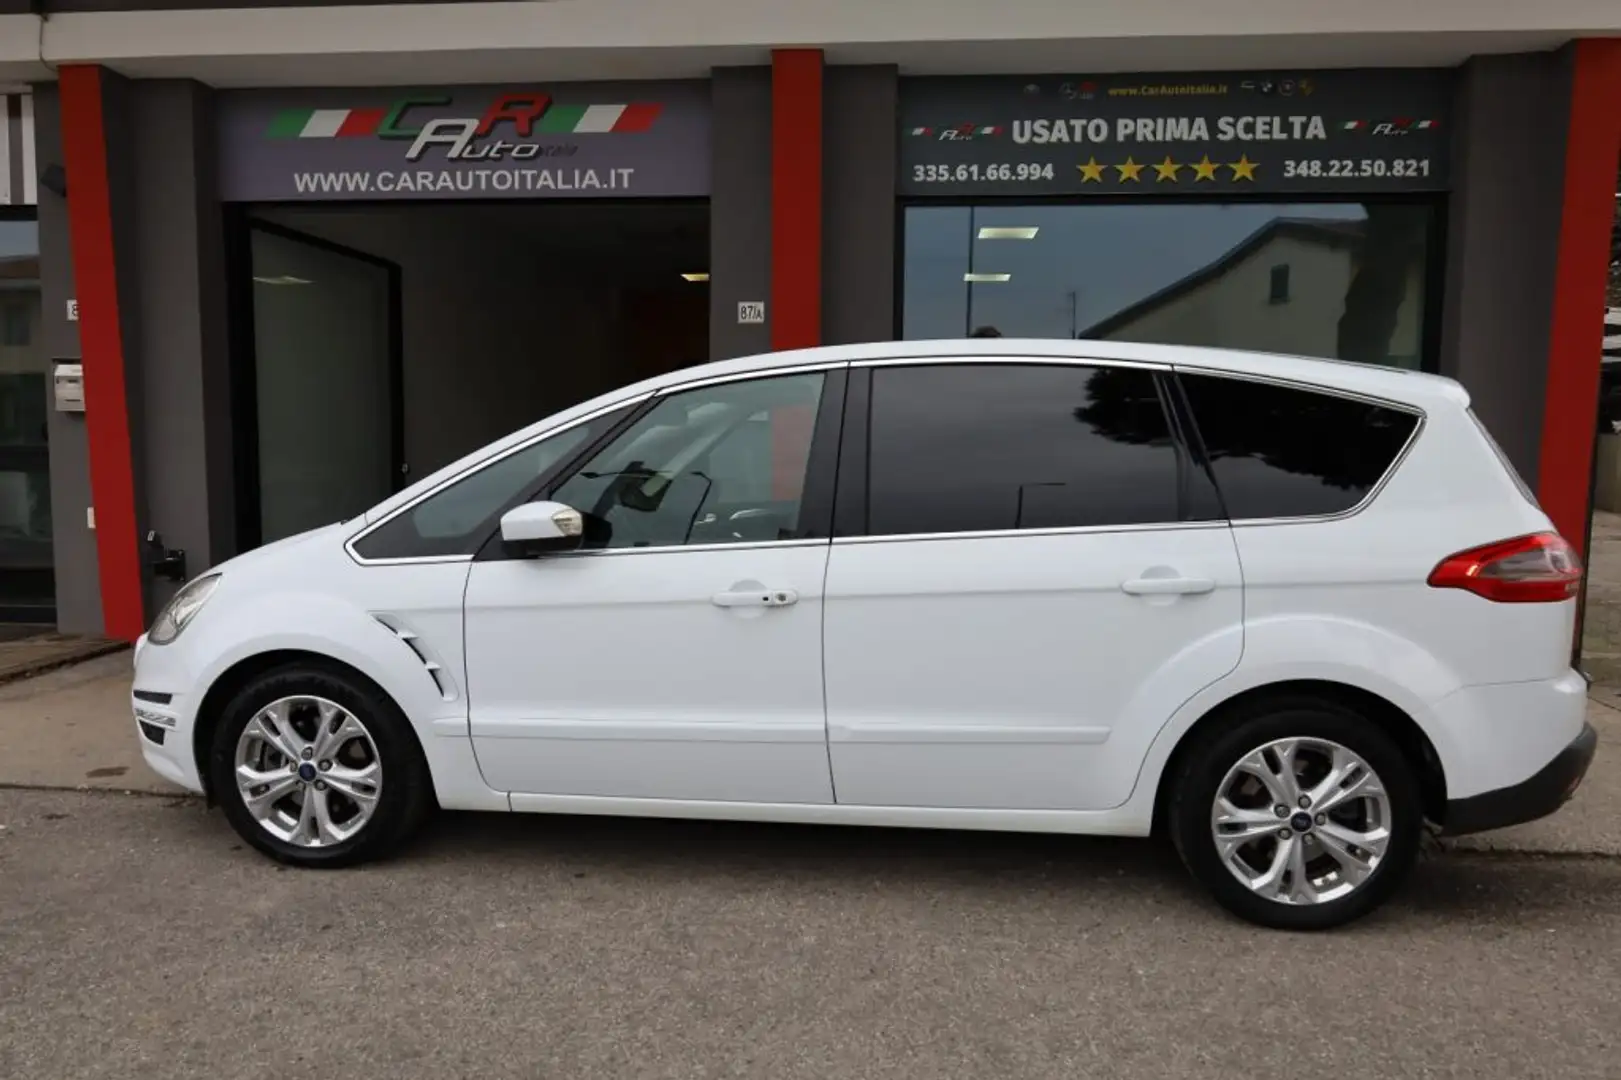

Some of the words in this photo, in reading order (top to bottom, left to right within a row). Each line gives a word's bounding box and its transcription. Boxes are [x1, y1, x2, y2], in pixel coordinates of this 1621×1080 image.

[1012, 118, 1107, 144] USATO
[1116, 116, 1209, 142] PRIMA
[1217, 115, 1327, 141] SCELTA
[294, 168, 634, 193] WWW.CARAUTOITALIA.IT
[913, 162, 1054, 183] 335.61.66.994
[1283, 159, 1430, 179] 348.22.50.821
